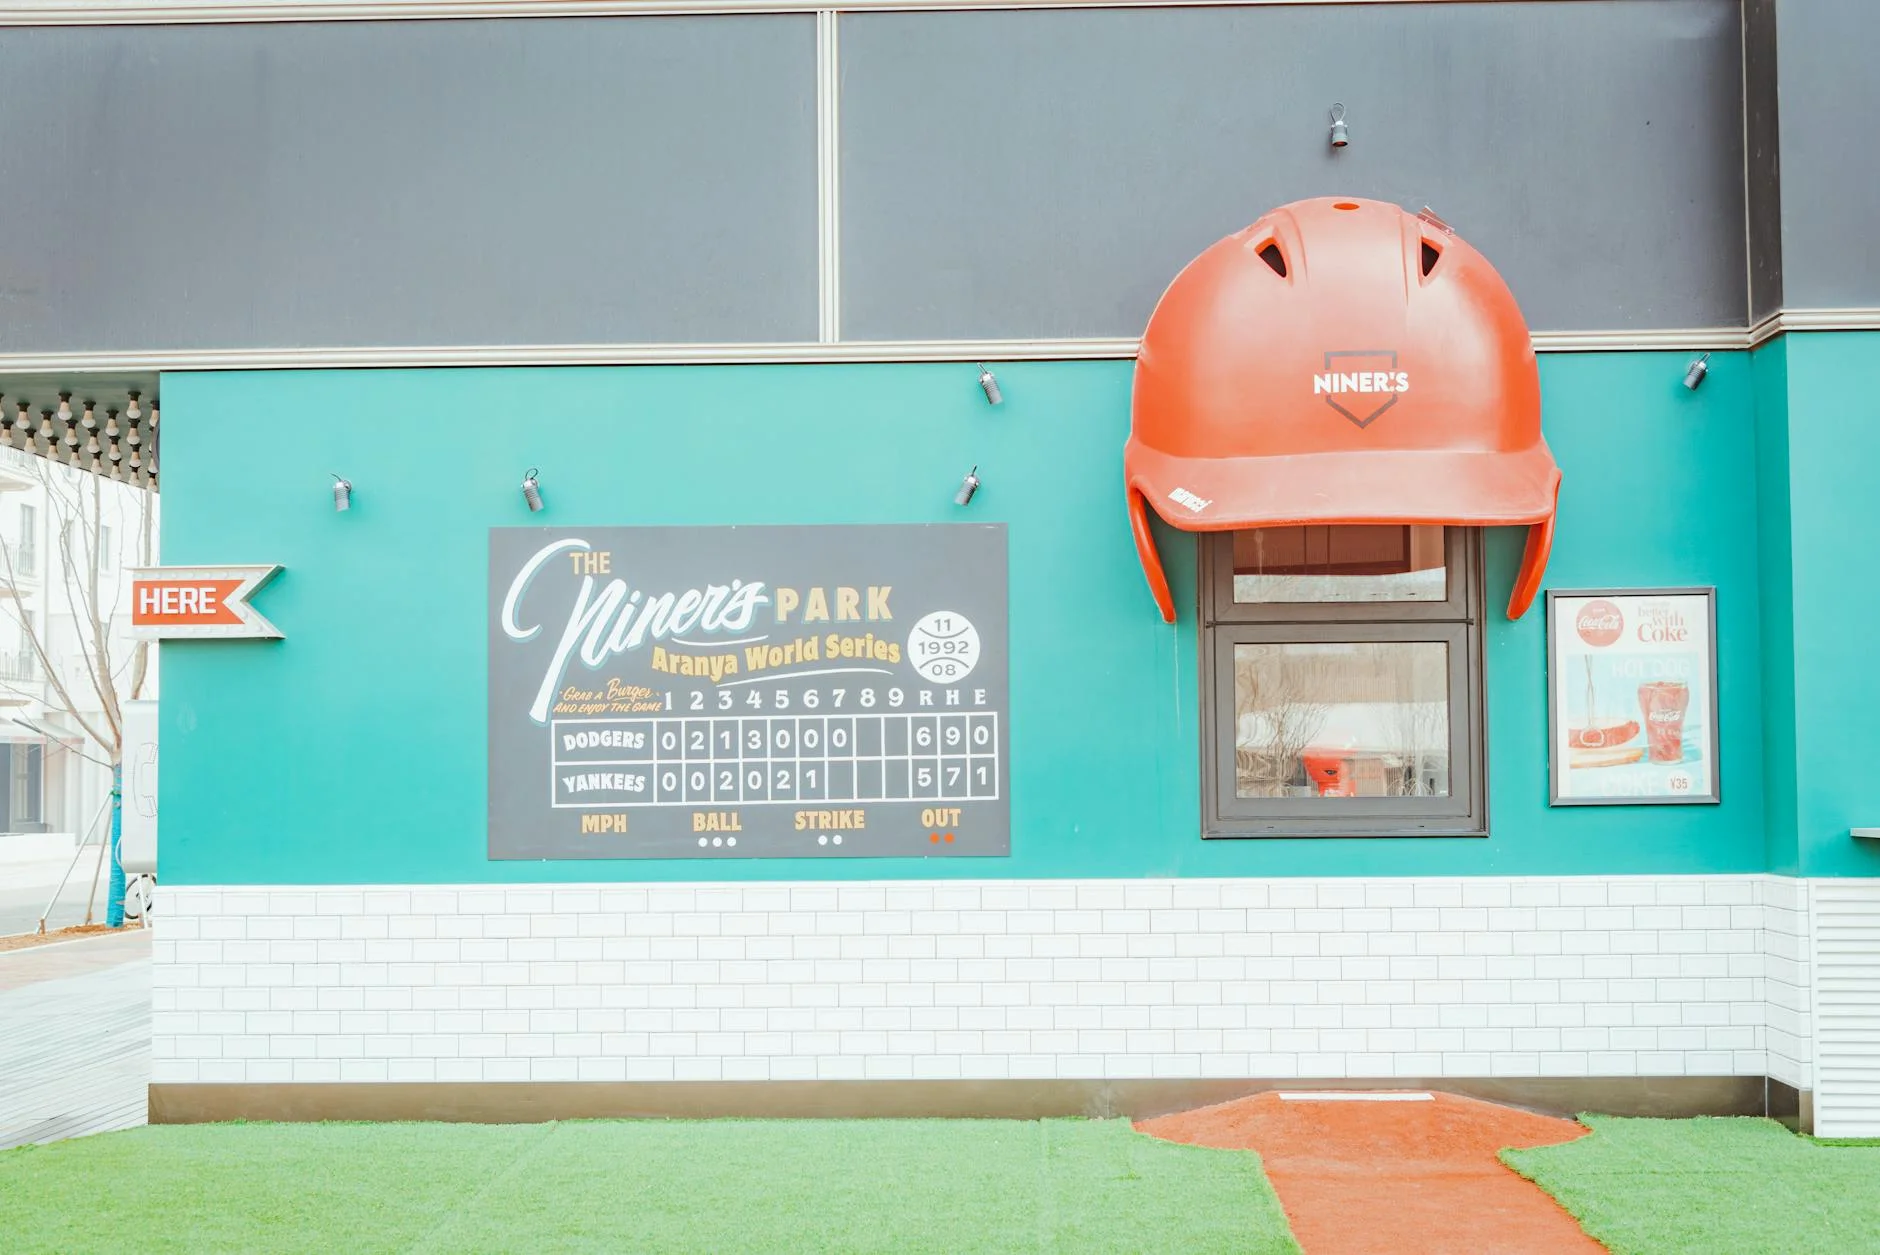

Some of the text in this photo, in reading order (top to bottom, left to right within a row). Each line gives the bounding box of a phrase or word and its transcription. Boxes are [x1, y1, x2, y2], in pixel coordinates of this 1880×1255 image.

[1313, 371, 1409, 394] NINER'S
[569, 552, 611, 575] THE
[140, 587, 217, 615] HERE
[501, 538, 894, 722] Niner's PARK
[934, 618, 951, 632] 11
[1637, 622, 1688, 643] Coke
[652, 632, 902, 683] Aranya World Series
[918, 640, 969, 655] 1992
[931, 664, 957, 677] 08
[606, 677, 654, 703] Burger
[665, 687, 986, 711] 1 2 3 4 5 6 7 8 9 R H E
[553, 701, 663, 715] AND ENJOY THE GAME
[563, 725, 989, 751] DODGERS 0 2 1 3 0 0 0 6 9 0
[562, 766, 987, 793] YANKEES 0 0 2 0 2 1 5 7 1
[581, 808, 962, 833] MPH BALL STRIKE OUT
